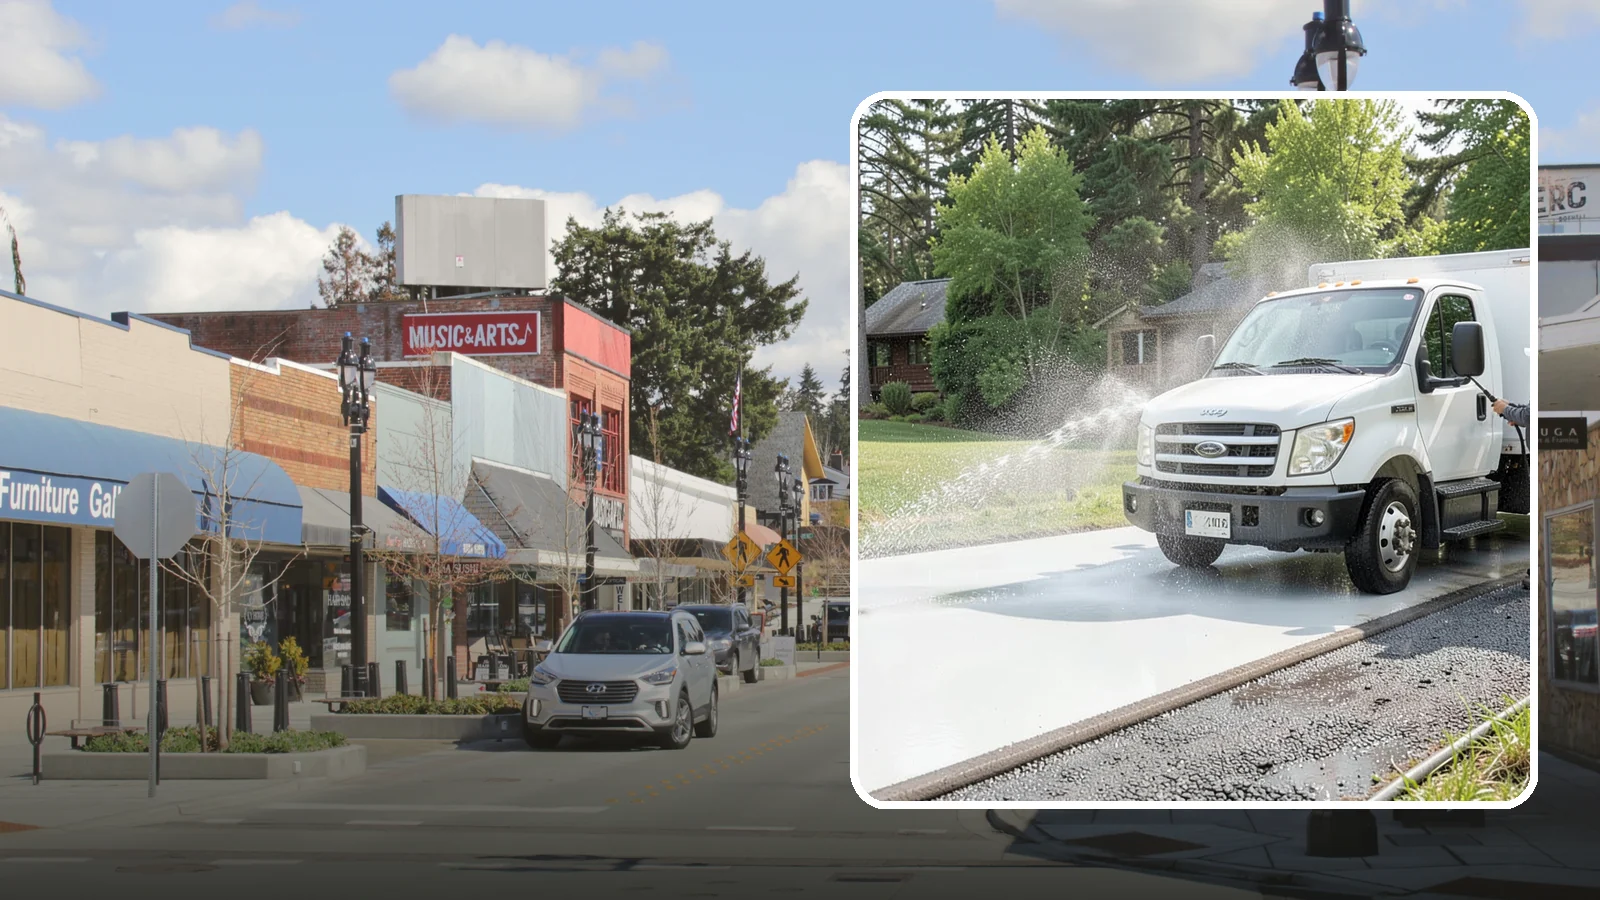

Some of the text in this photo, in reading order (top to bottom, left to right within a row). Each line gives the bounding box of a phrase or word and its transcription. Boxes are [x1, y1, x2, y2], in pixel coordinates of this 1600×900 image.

[408, 322, 520, 349] MUSIC&ARTS
[1540, 427, 1577, 436] UGA
[0, 470, 79, 515] Furniture
[453, 563, 480, 574] SUSHI
